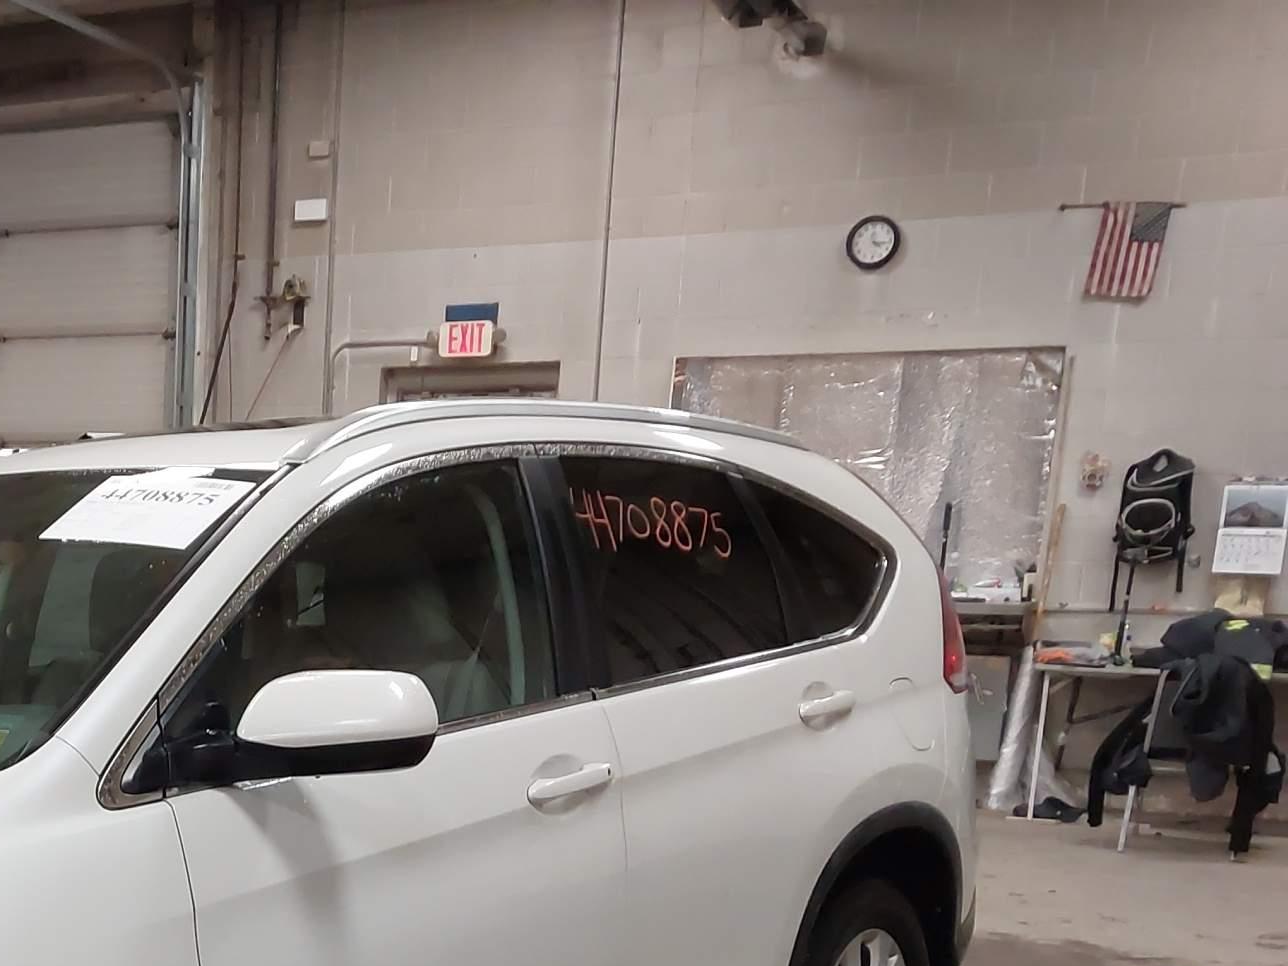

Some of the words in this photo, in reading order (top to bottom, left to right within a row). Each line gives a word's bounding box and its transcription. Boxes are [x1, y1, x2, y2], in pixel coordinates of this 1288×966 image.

[448, 323, 486, 354] EXIT
[101, 488, 220, 507] 44708875
[568, 486, 732, 558] 44708875
